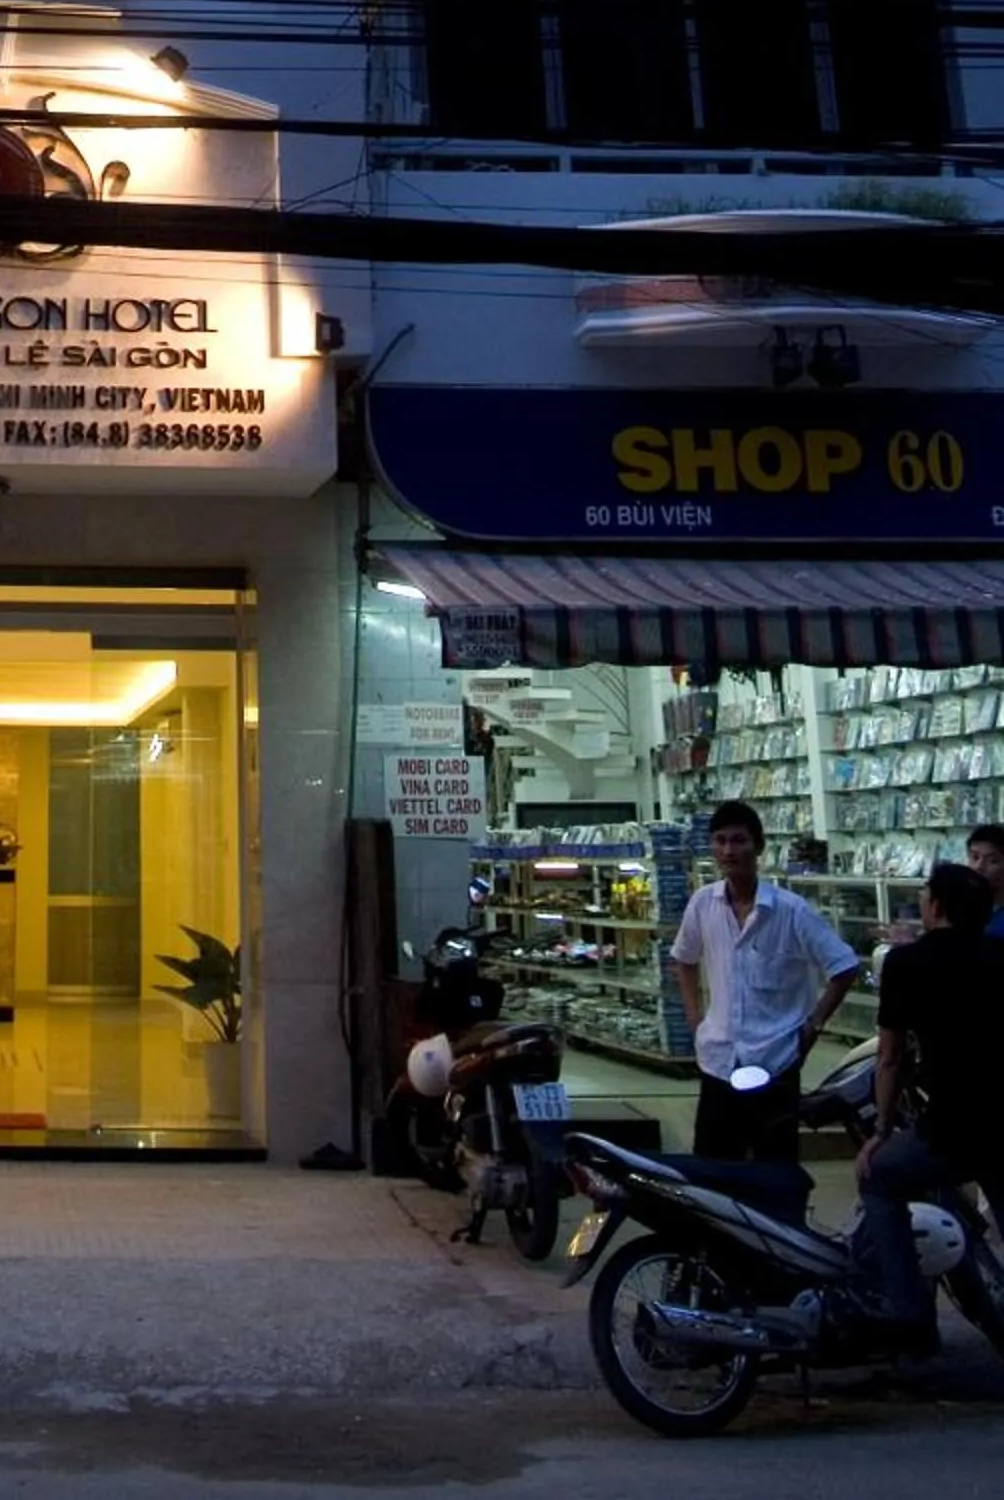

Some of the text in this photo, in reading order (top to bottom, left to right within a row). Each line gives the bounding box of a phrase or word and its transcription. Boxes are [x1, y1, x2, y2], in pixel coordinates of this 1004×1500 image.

[84, 299, 219, 333] HOTEL
[61, 339, 117, 367] SÀI
[124, 341, 208, 369] GÒN
[30, 385, 86, 409] MINH
[164, 388, 266, 414] VIETNAM
[4, 419, 57, 446] FAX:
[611, 426, 965, 493] SHOP 60
[585, 500, 712, 531] 60 BÙI VIỆN
[397, 759, 470, 775] MOBI CARD
[400, 779, 469, 795] VINA CARD
[389, 799, 482, 815] VIETTEL CARD
[405, 819, 469, 834] SIM CARD
